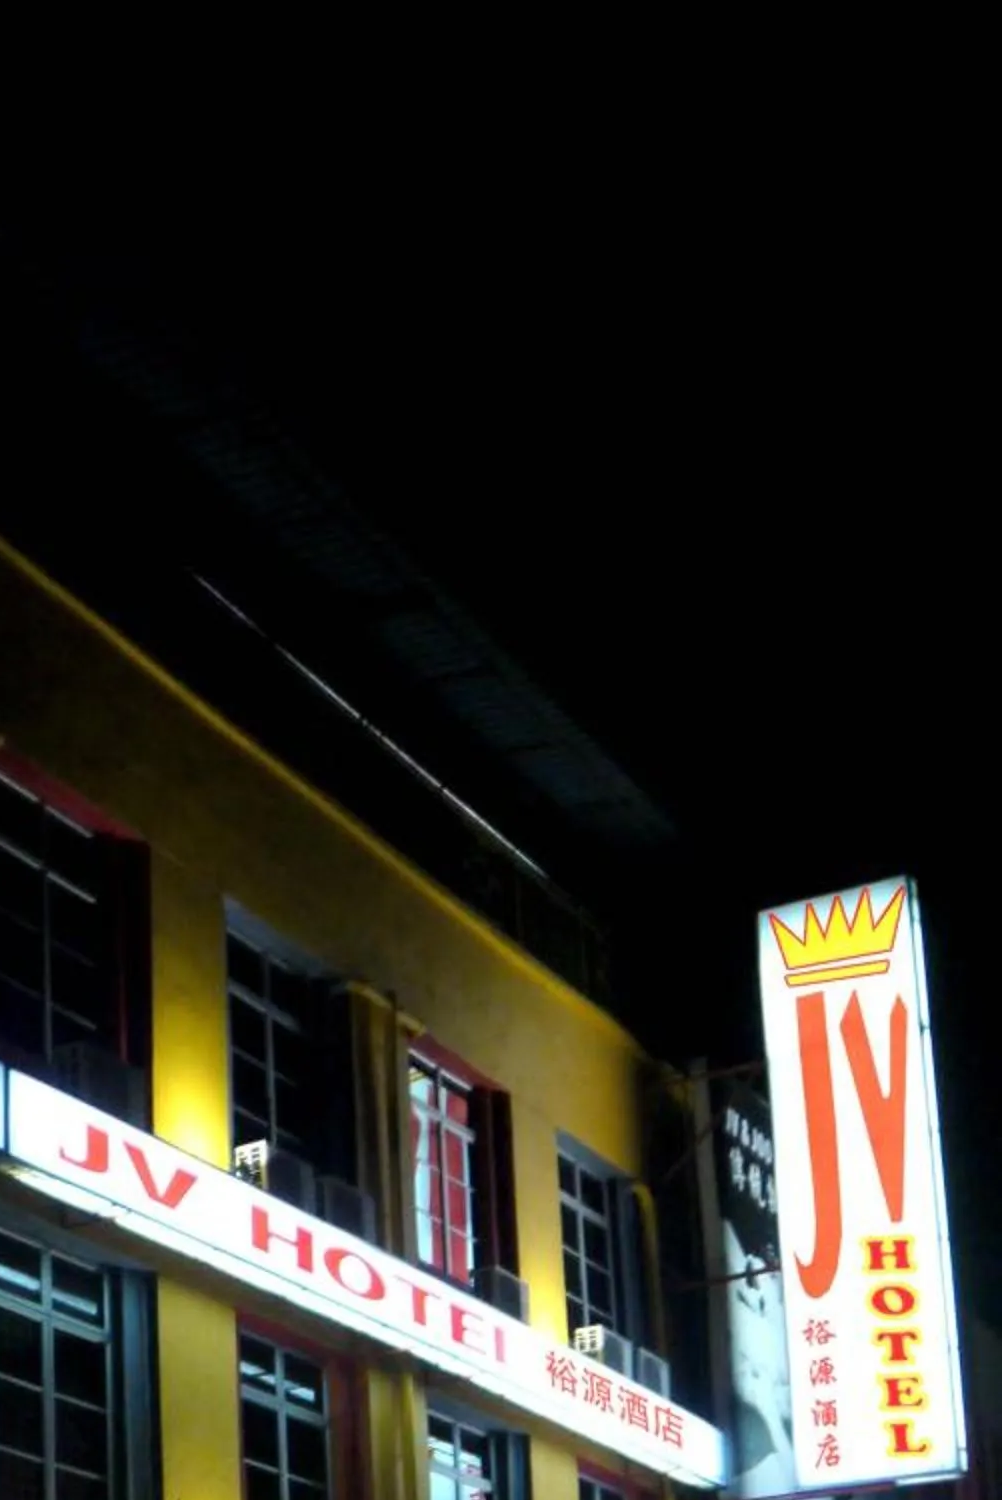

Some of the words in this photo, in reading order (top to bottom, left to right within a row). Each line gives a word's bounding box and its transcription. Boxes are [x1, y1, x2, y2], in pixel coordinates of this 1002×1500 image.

[59, 1125, 197, 1210] JV
[794, 991, 909, 1299] JV
[545, 1351, 684, 1448] 裕源酒店
[802, 1319, 840, 1469] 裕源酒店
[865, 1237, 928, 1455] HOTEL
